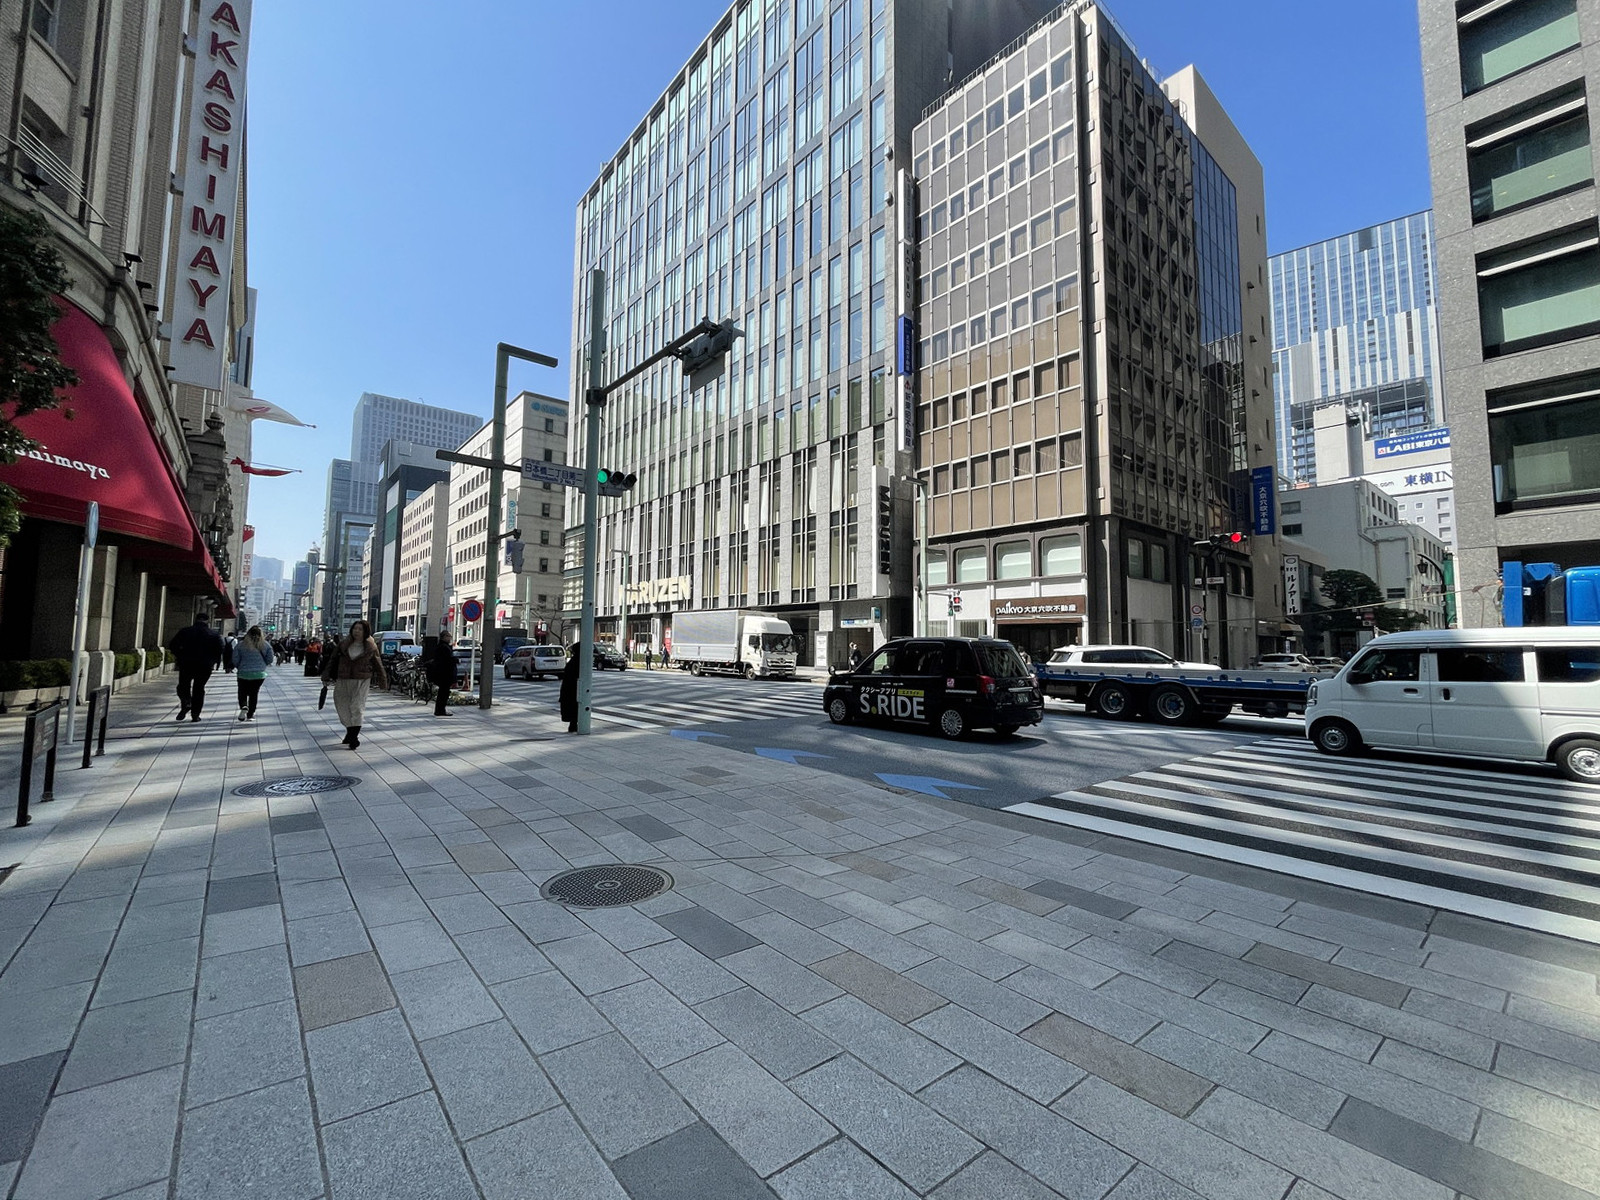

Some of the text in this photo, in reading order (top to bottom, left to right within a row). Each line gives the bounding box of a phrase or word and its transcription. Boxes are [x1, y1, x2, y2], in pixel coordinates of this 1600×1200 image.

[180, 1, 241, 349] AKASHIMAYA
[1287, 574, 1298, 614] ルノアール
[860, 686, 896, 695] タクシーアプリ
[860, 692, 925, 719] S.RIDE
